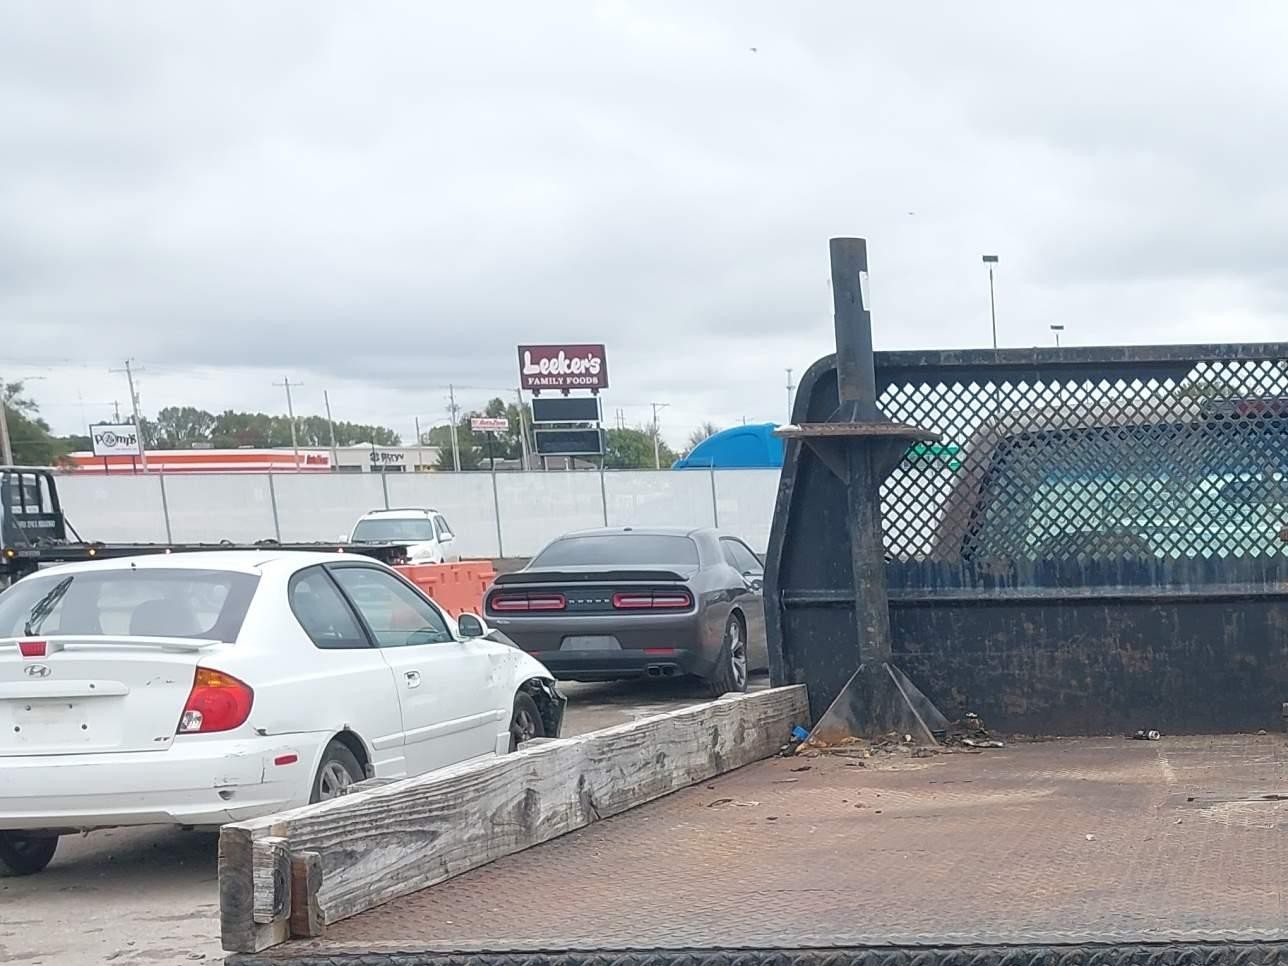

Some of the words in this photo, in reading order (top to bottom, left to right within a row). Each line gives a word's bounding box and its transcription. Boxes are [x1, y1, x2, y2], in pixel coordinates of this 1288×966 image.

[523, 350, 601, 375] Leeker's
[527, 377, 564, 385] FAMILY
[566, 376, 599, 385] FOODS
